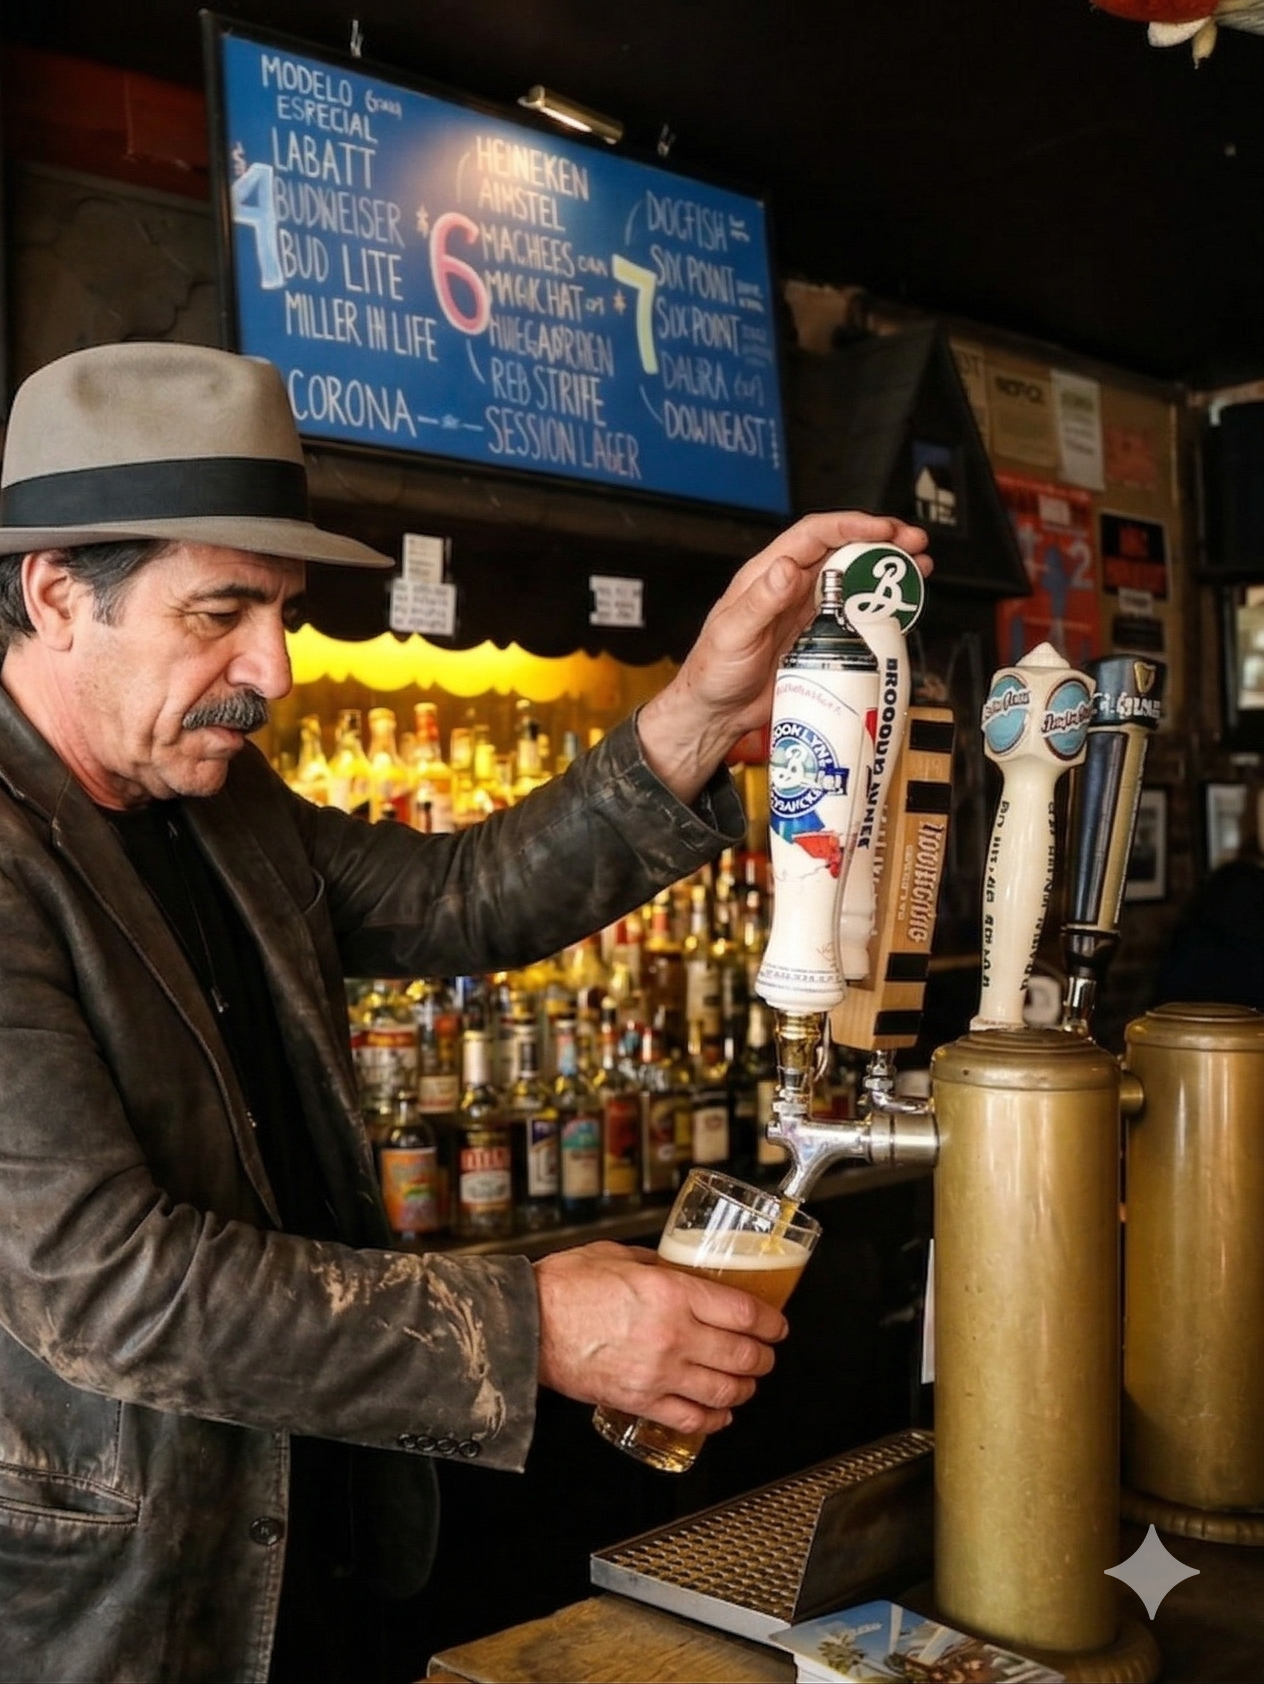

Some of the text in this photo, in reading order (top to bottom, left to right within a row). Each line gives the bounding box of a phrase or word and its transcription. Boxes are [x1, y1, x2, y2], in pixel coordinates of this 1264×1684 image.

[260, 53, 354, 107] MODELO
[271, 126, 377, 190] LABATT
[279, 228, 404, 302] BUD LITE
[284, 289, 363, 346] MILLER
[391, 311, 439, 362] LIFE
[288, 369, 418, 438] CORONA
[486, 405, 577, 467] SESSION
